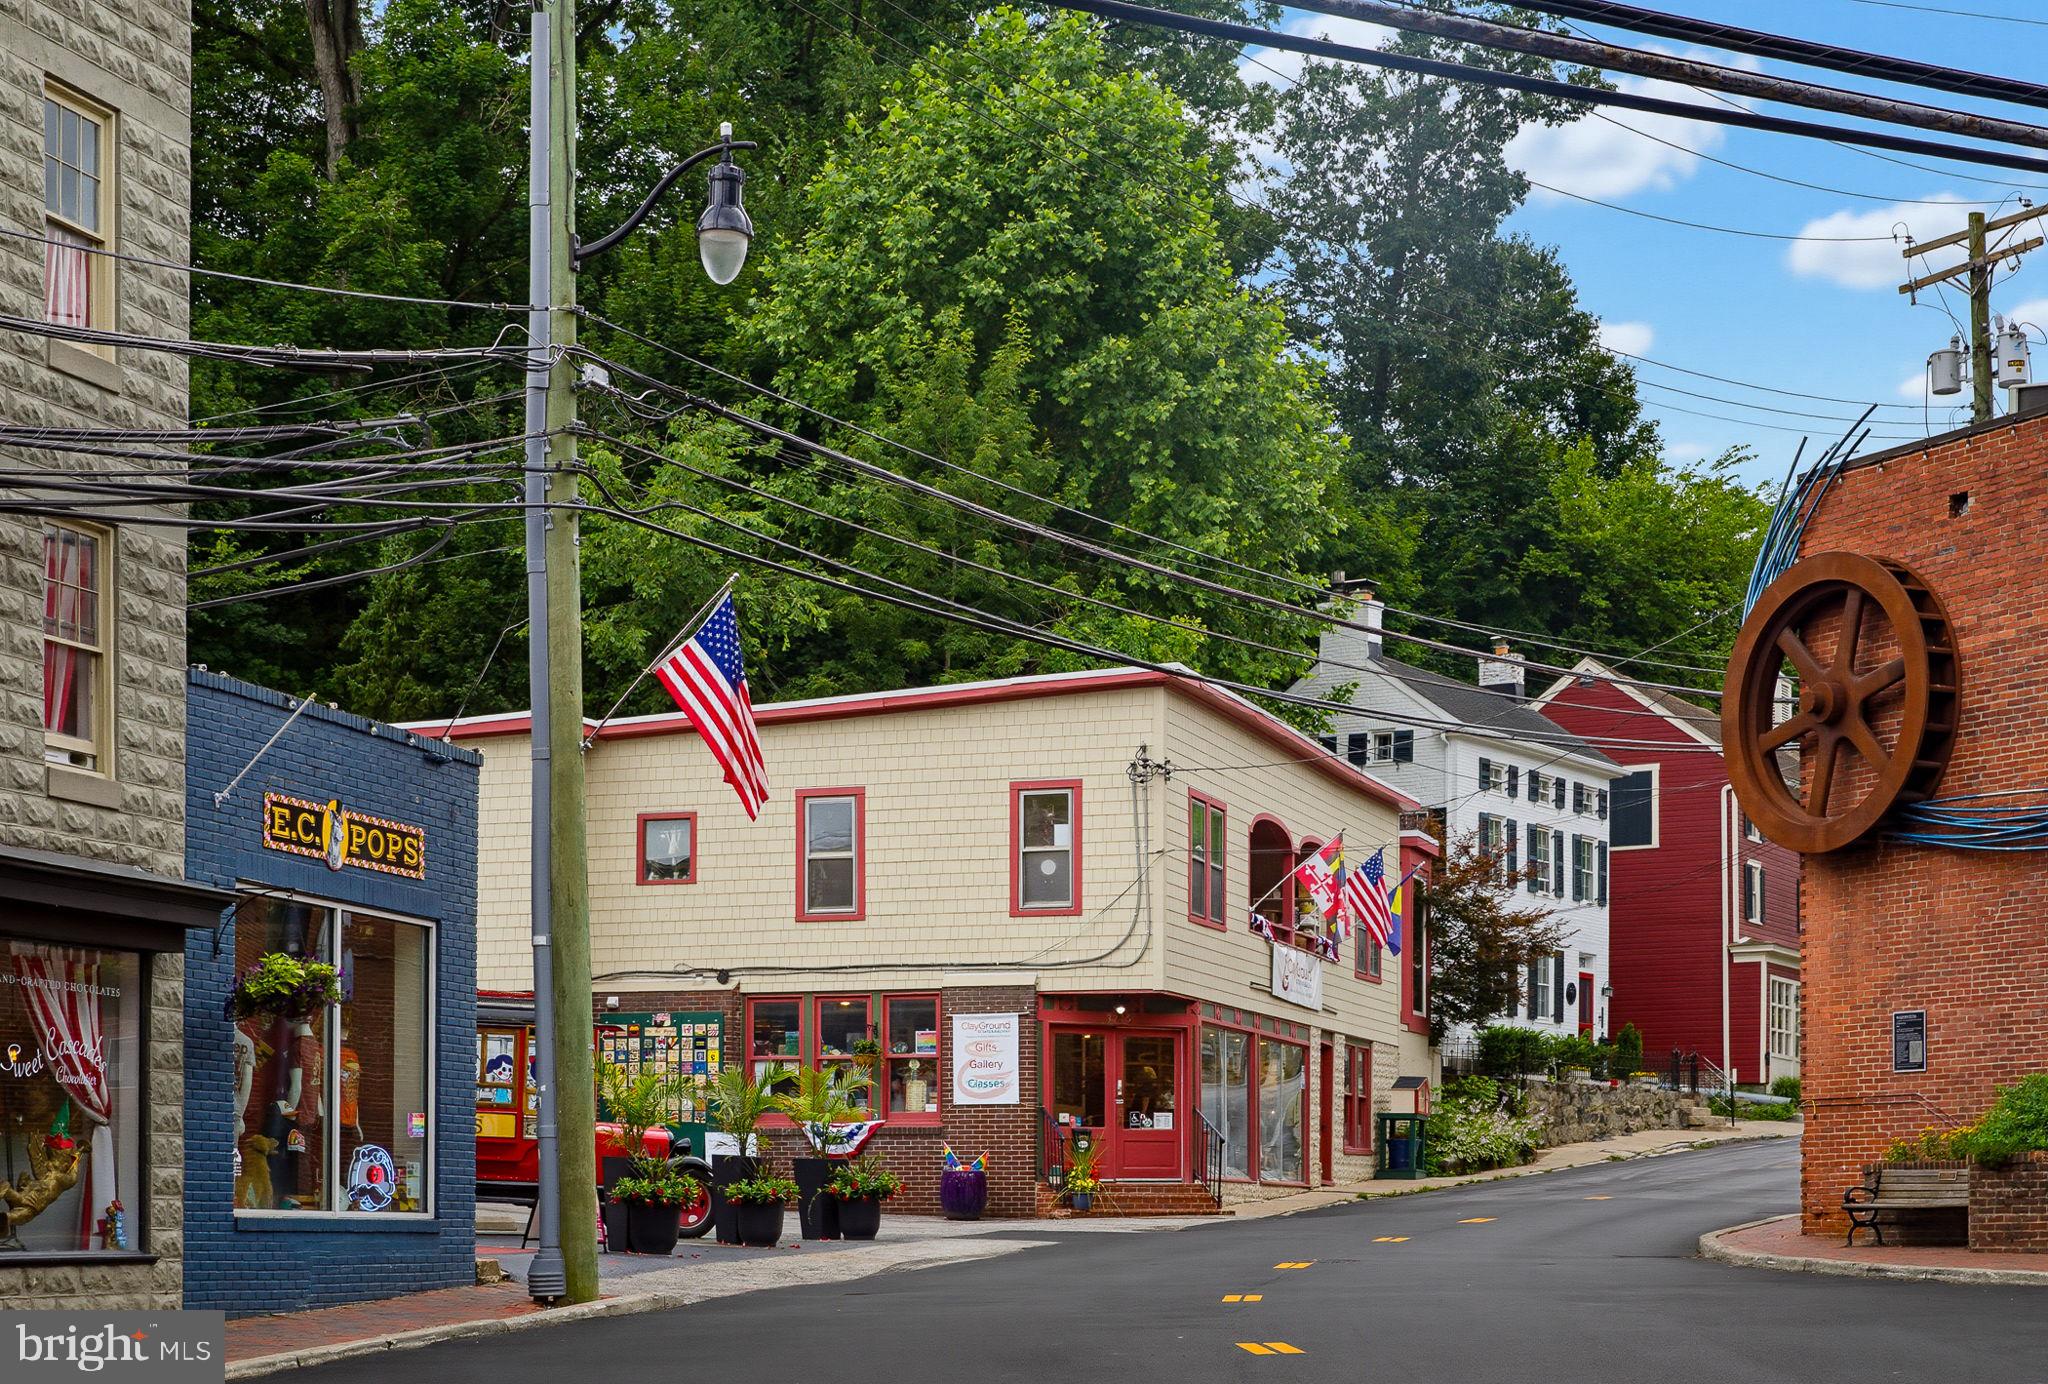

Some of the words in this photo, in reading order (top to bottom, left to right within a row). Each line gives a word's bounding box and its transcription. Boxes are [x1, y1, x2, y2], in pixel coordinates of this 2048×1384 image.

[271, 806, 321, 846] E.C.
[350, 824, 419, 867] POPS
[0, 974, 61, 990] ND-CRAFTED
[64, 981, 121, 998] CHOCOLATES
[961, 1020, 1011, 1031] ClayGround
[0, 1043, 44, 1078] Sweet
[46, 1026, 108, 1073] Cascades
[975, 1042, 998, 1053] Gifts
[969, 1059, 1004, 1071] Gallery
[967, 1079, 1006, 1089] Classes
